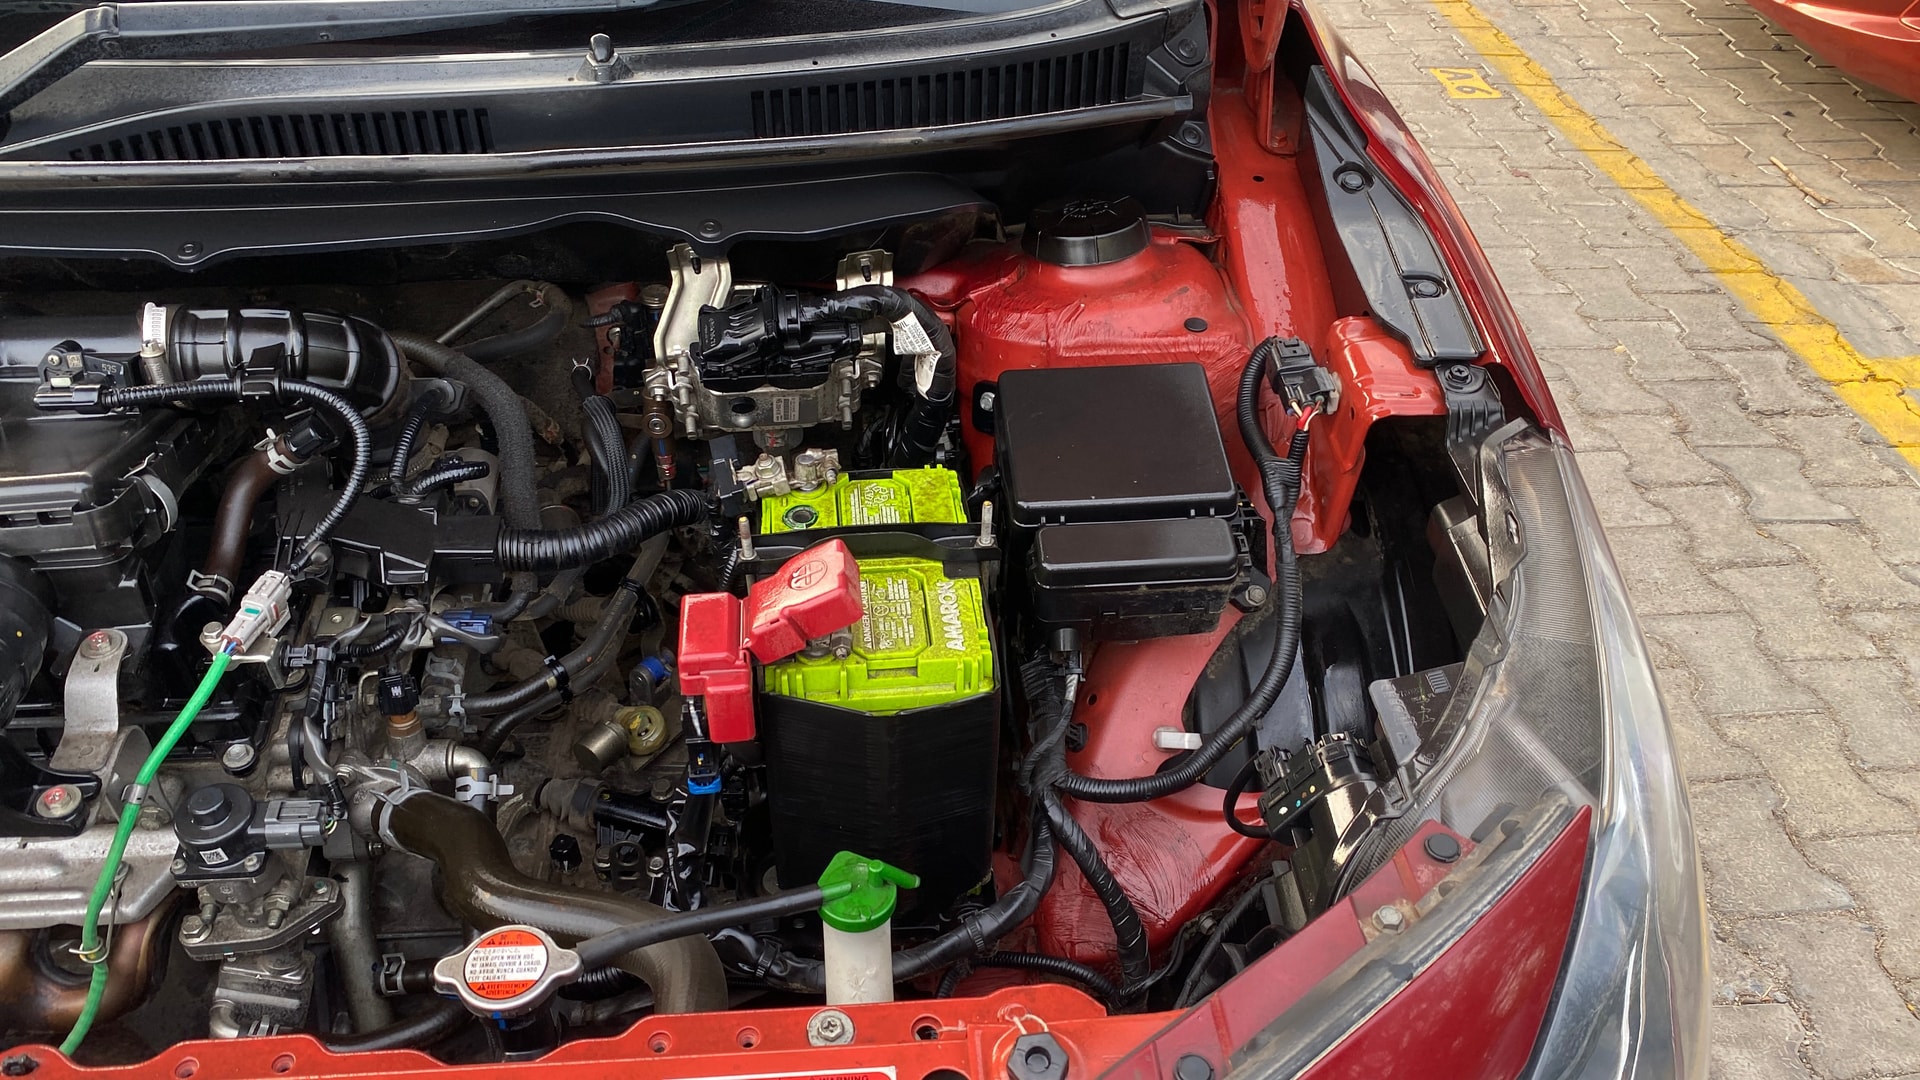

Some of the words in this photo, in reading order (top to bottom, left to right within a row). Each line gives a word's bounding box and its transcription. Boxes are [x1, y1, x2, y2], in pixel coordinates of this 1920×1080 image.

[101, 363, 117, 373] 53S
[862, 615, 872, 642] DANGER
[936, 580, 966, 651] AMARON
